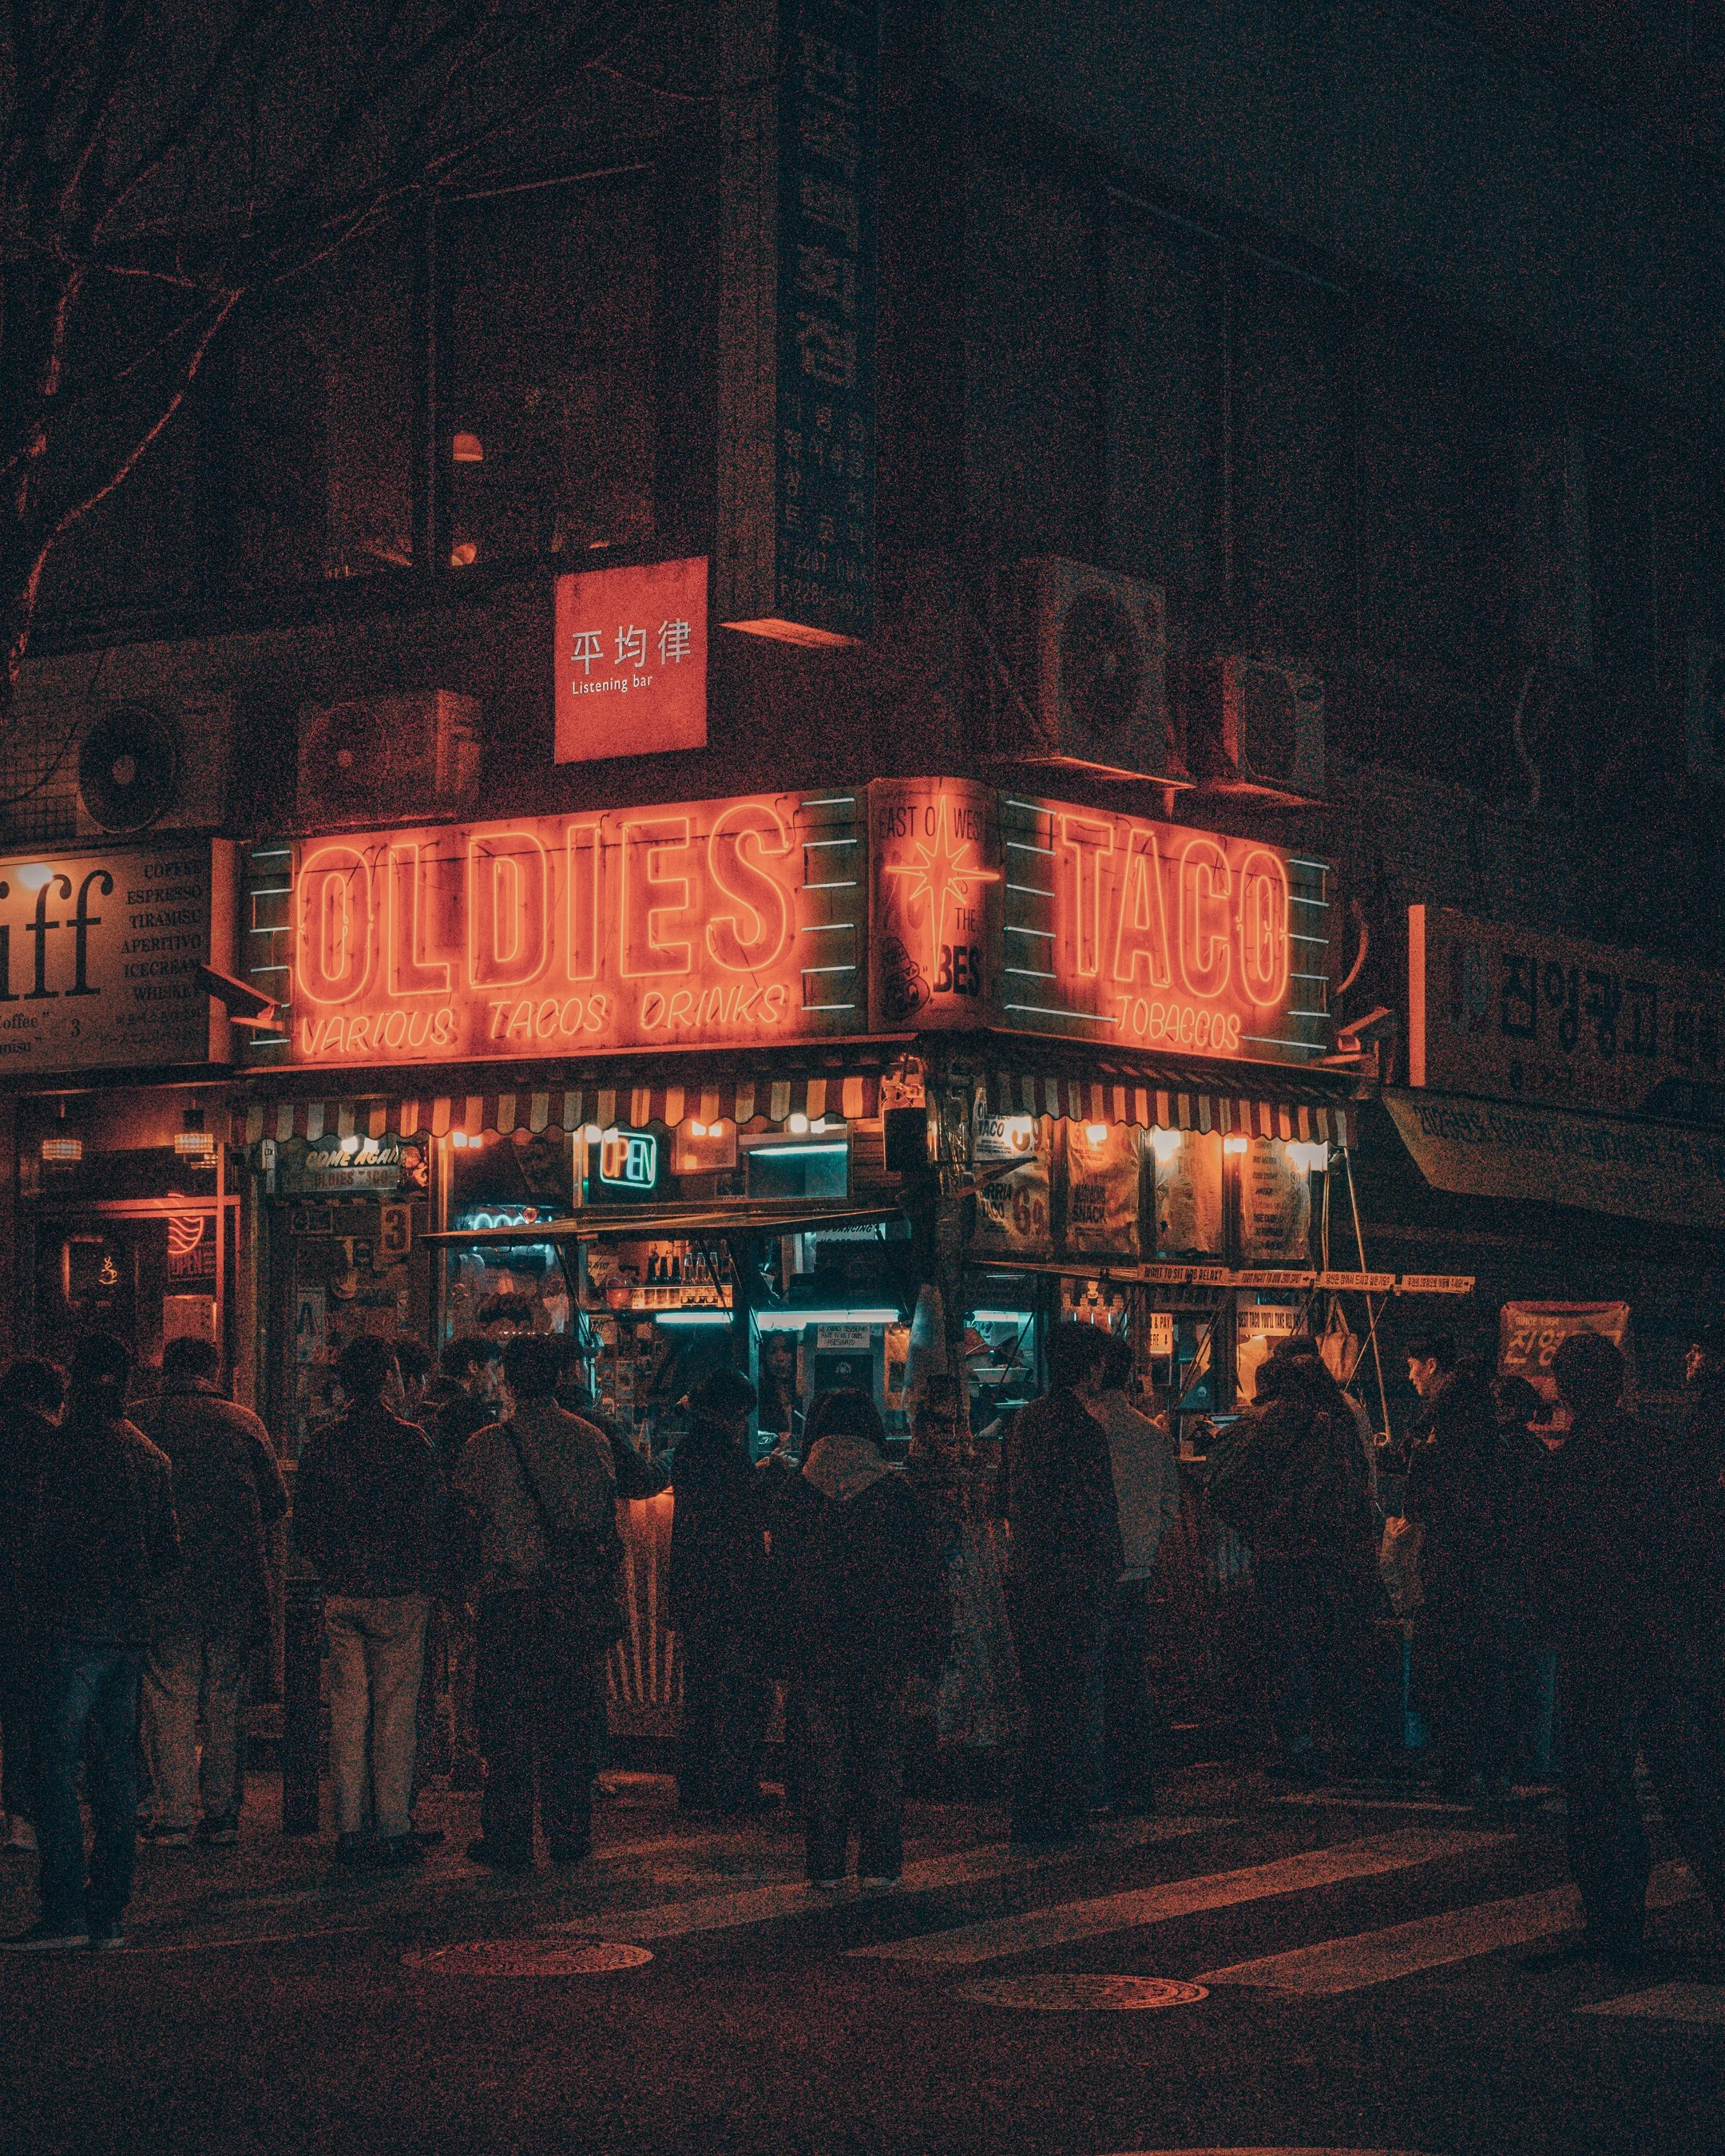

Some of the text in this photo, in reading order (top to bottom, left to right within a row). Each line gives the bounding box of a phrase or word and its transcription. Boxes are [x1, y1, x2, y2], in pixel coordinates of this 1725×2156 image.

[570, 617, 692, 676] 平均律
[572, 674, 653, 696] Listening bar
[880, 806, 918, 839] EAST
[144, 859, 202, 879] COFFEE
[127, 884, 202, 905] ESPRESSO
[296, 802, 792, 1006] OLDIES
[129, 909, 201, 929] TIRAMISU
[955, 907, 976, 932] THE
[1057, 812, 1291, 1008] TACO
[121, 933, 201, 954] APERITIVO
[124, 958, 202, 978] ICECREAM
[301, 982, 790, 1058] VARIOUS TACOS DRINKS
[1116, 994, 1241, 1052] TOBACCOS
[978, 1120, 1005, 1138] TACO
[305, 1148, 352, 1168] COME
[602, 1136, 654, 1182] OPEN
[383, 1209, 406, 1250] 3
[1144, 1266, 1163, 1278] WANT
[1164, 1267, 1172, 1279] TO
[1173, 1268, 1183, 1280] SIT
[1199, 1269, 1223, 1282] RELAX?
[1160, 1316, 1171, 1329] PAY
[1249, 1311, 1260, 1328] TACO
[1275, 1313, 1285, 1329] TAKE
